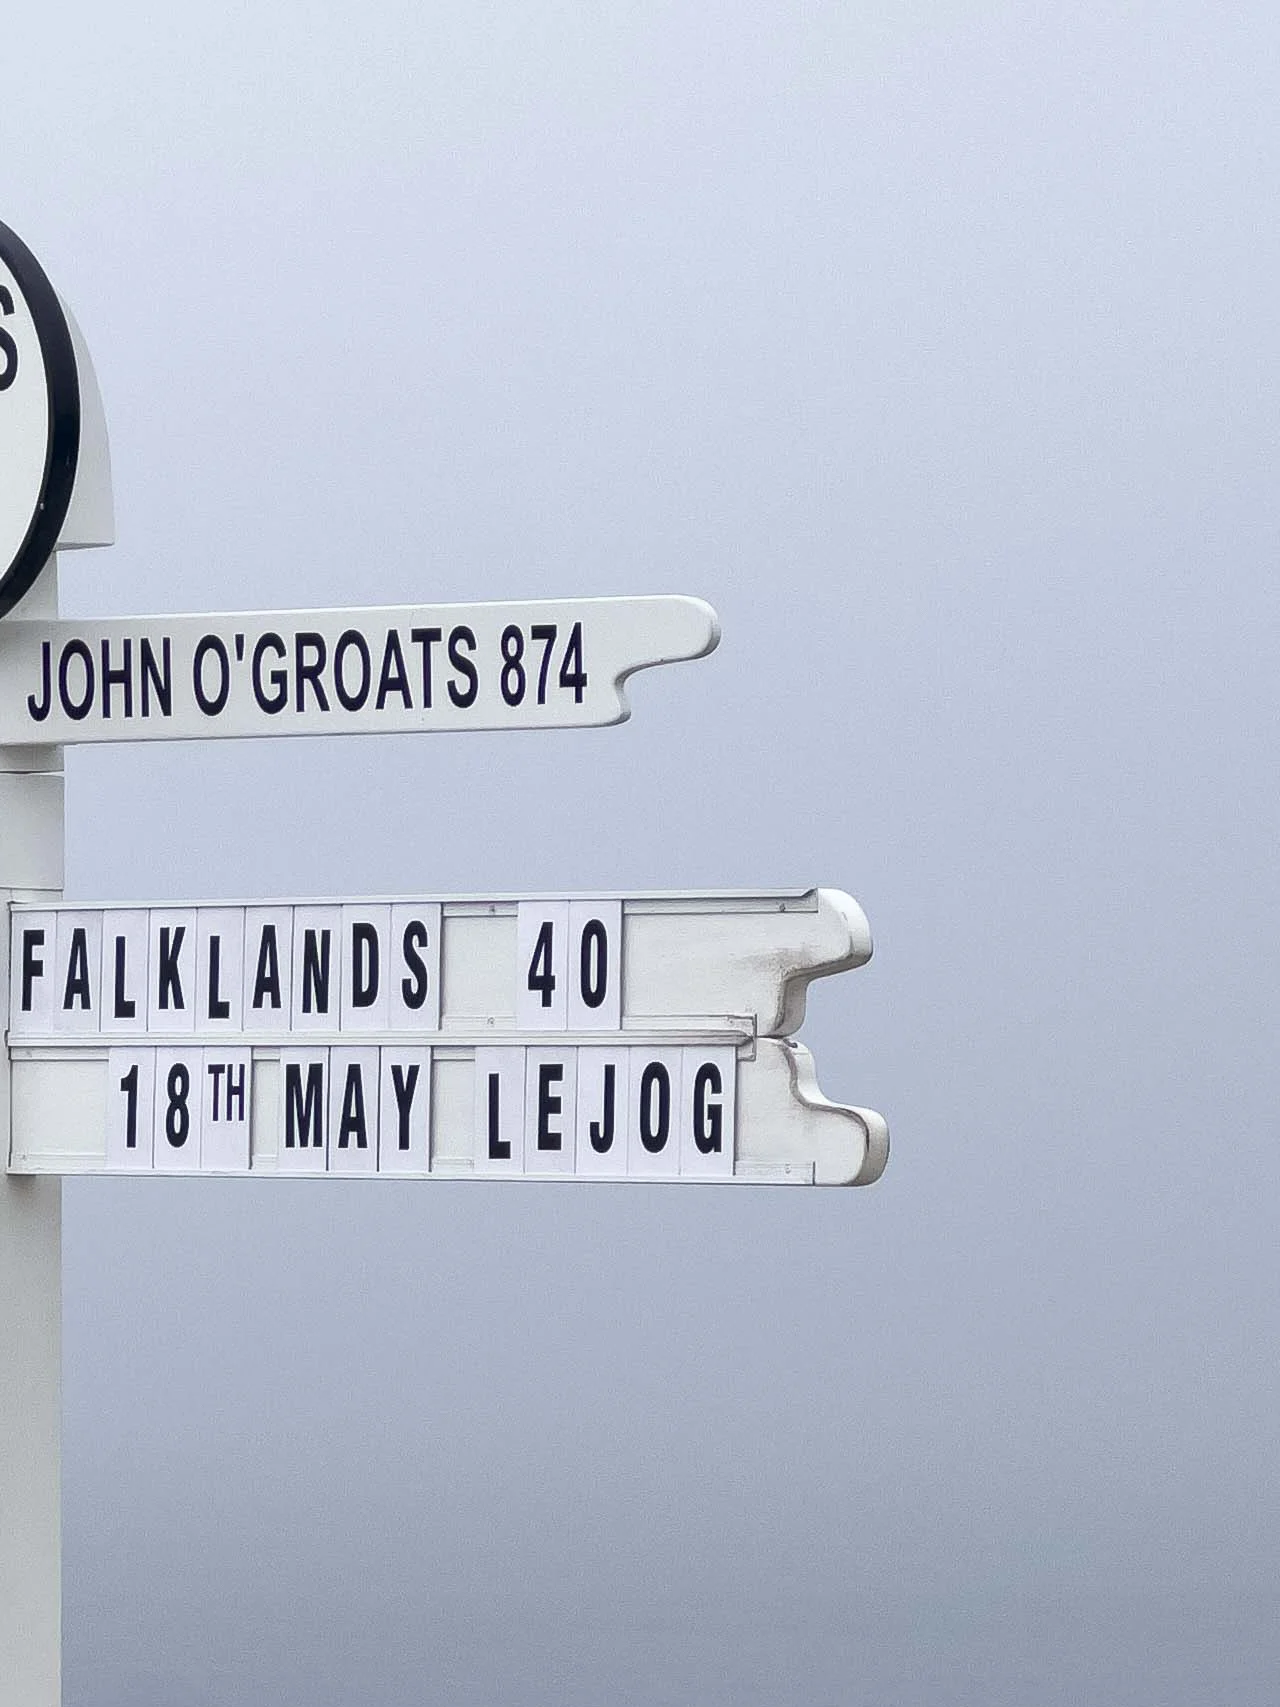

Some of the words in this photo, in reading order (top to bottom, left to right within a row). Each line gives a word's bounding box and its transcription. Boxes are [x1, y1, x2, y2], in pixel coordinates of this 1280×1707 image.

[27, 637, 172, 722] JOHN
[192, 625, 479, 717] O'GROATS
[500, 621, 588, 707] 874
[21, 920, 428, 1019] FALKLANDS
[527, 919, 608, 1009] 40
[120, 1062, 245, 1148] 18TH
[284, 1062, 421, 1151] MAY
[488, 1061, 723, 1160] LEJOG
